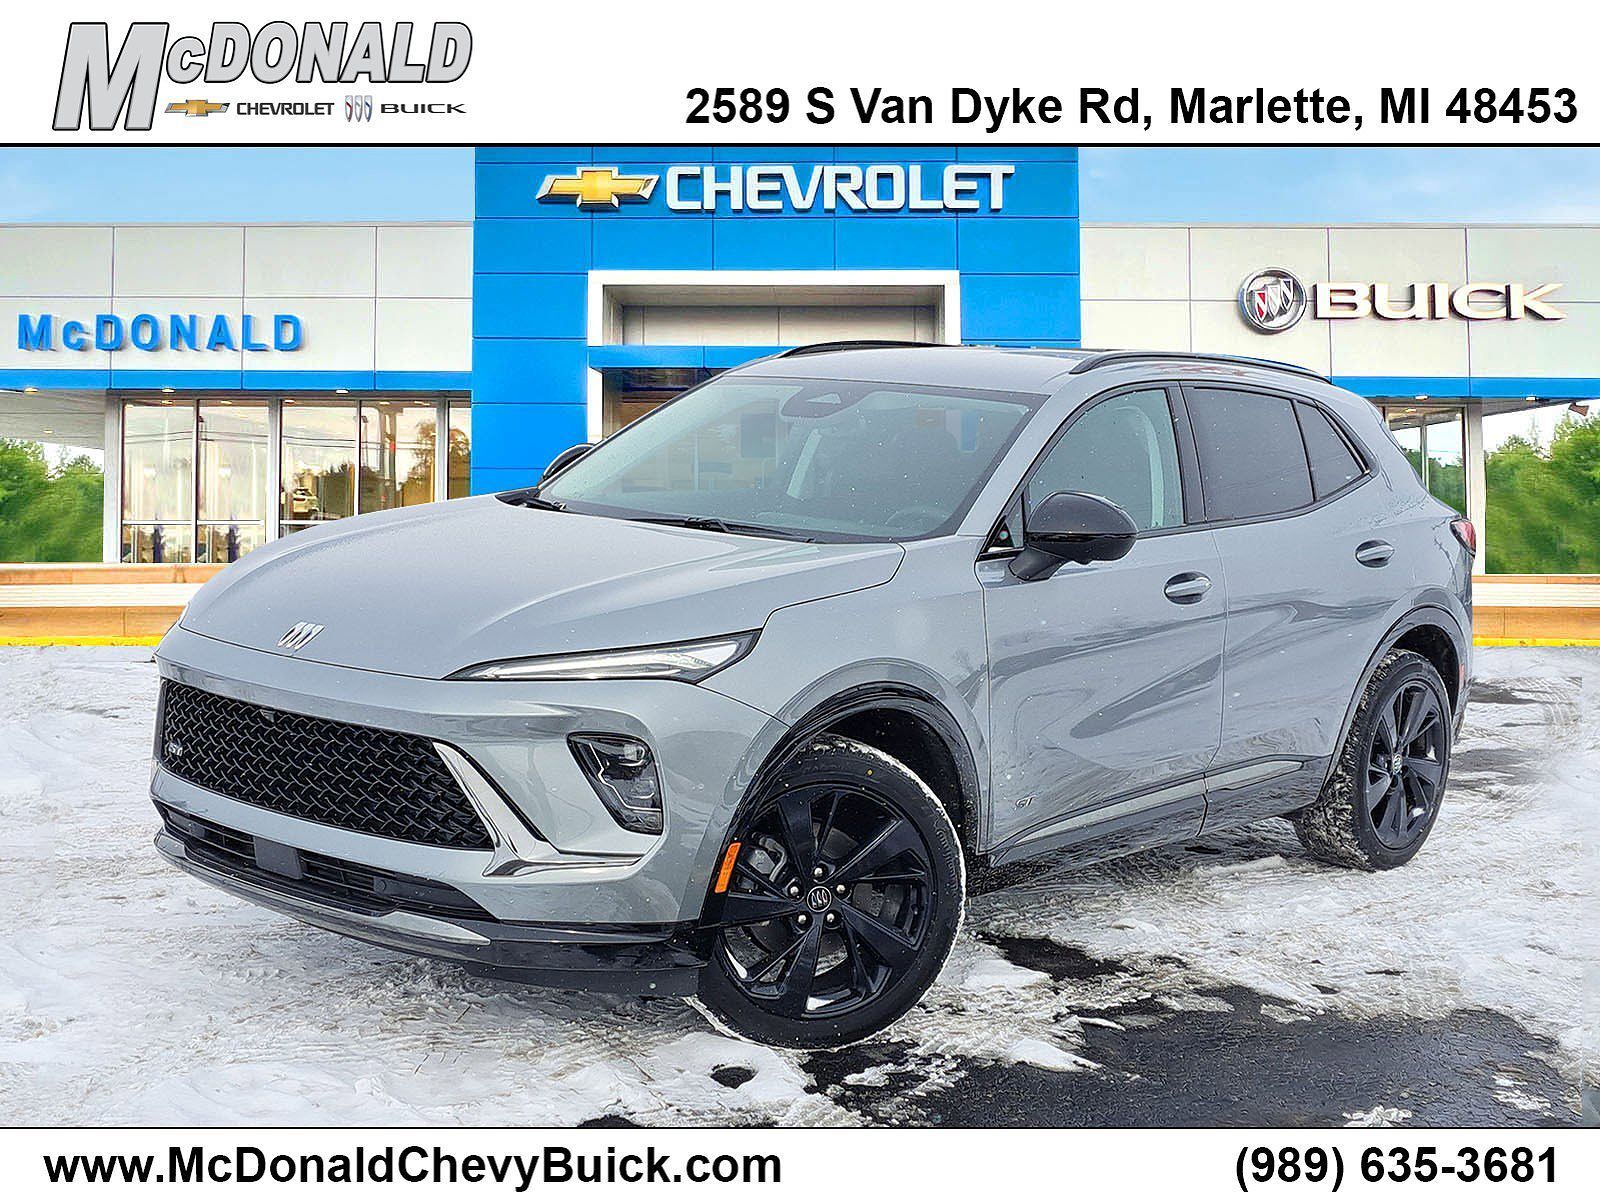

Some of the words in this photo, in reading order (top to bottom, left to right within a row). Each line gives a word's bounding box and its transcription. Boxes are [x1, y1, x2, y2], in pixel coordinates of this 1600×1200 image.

[666, 164, 1015, 212] CHEVROLET
[1313, 282, 1567, 320] BUICK
[17, 314, 304, 351] McDONALD
